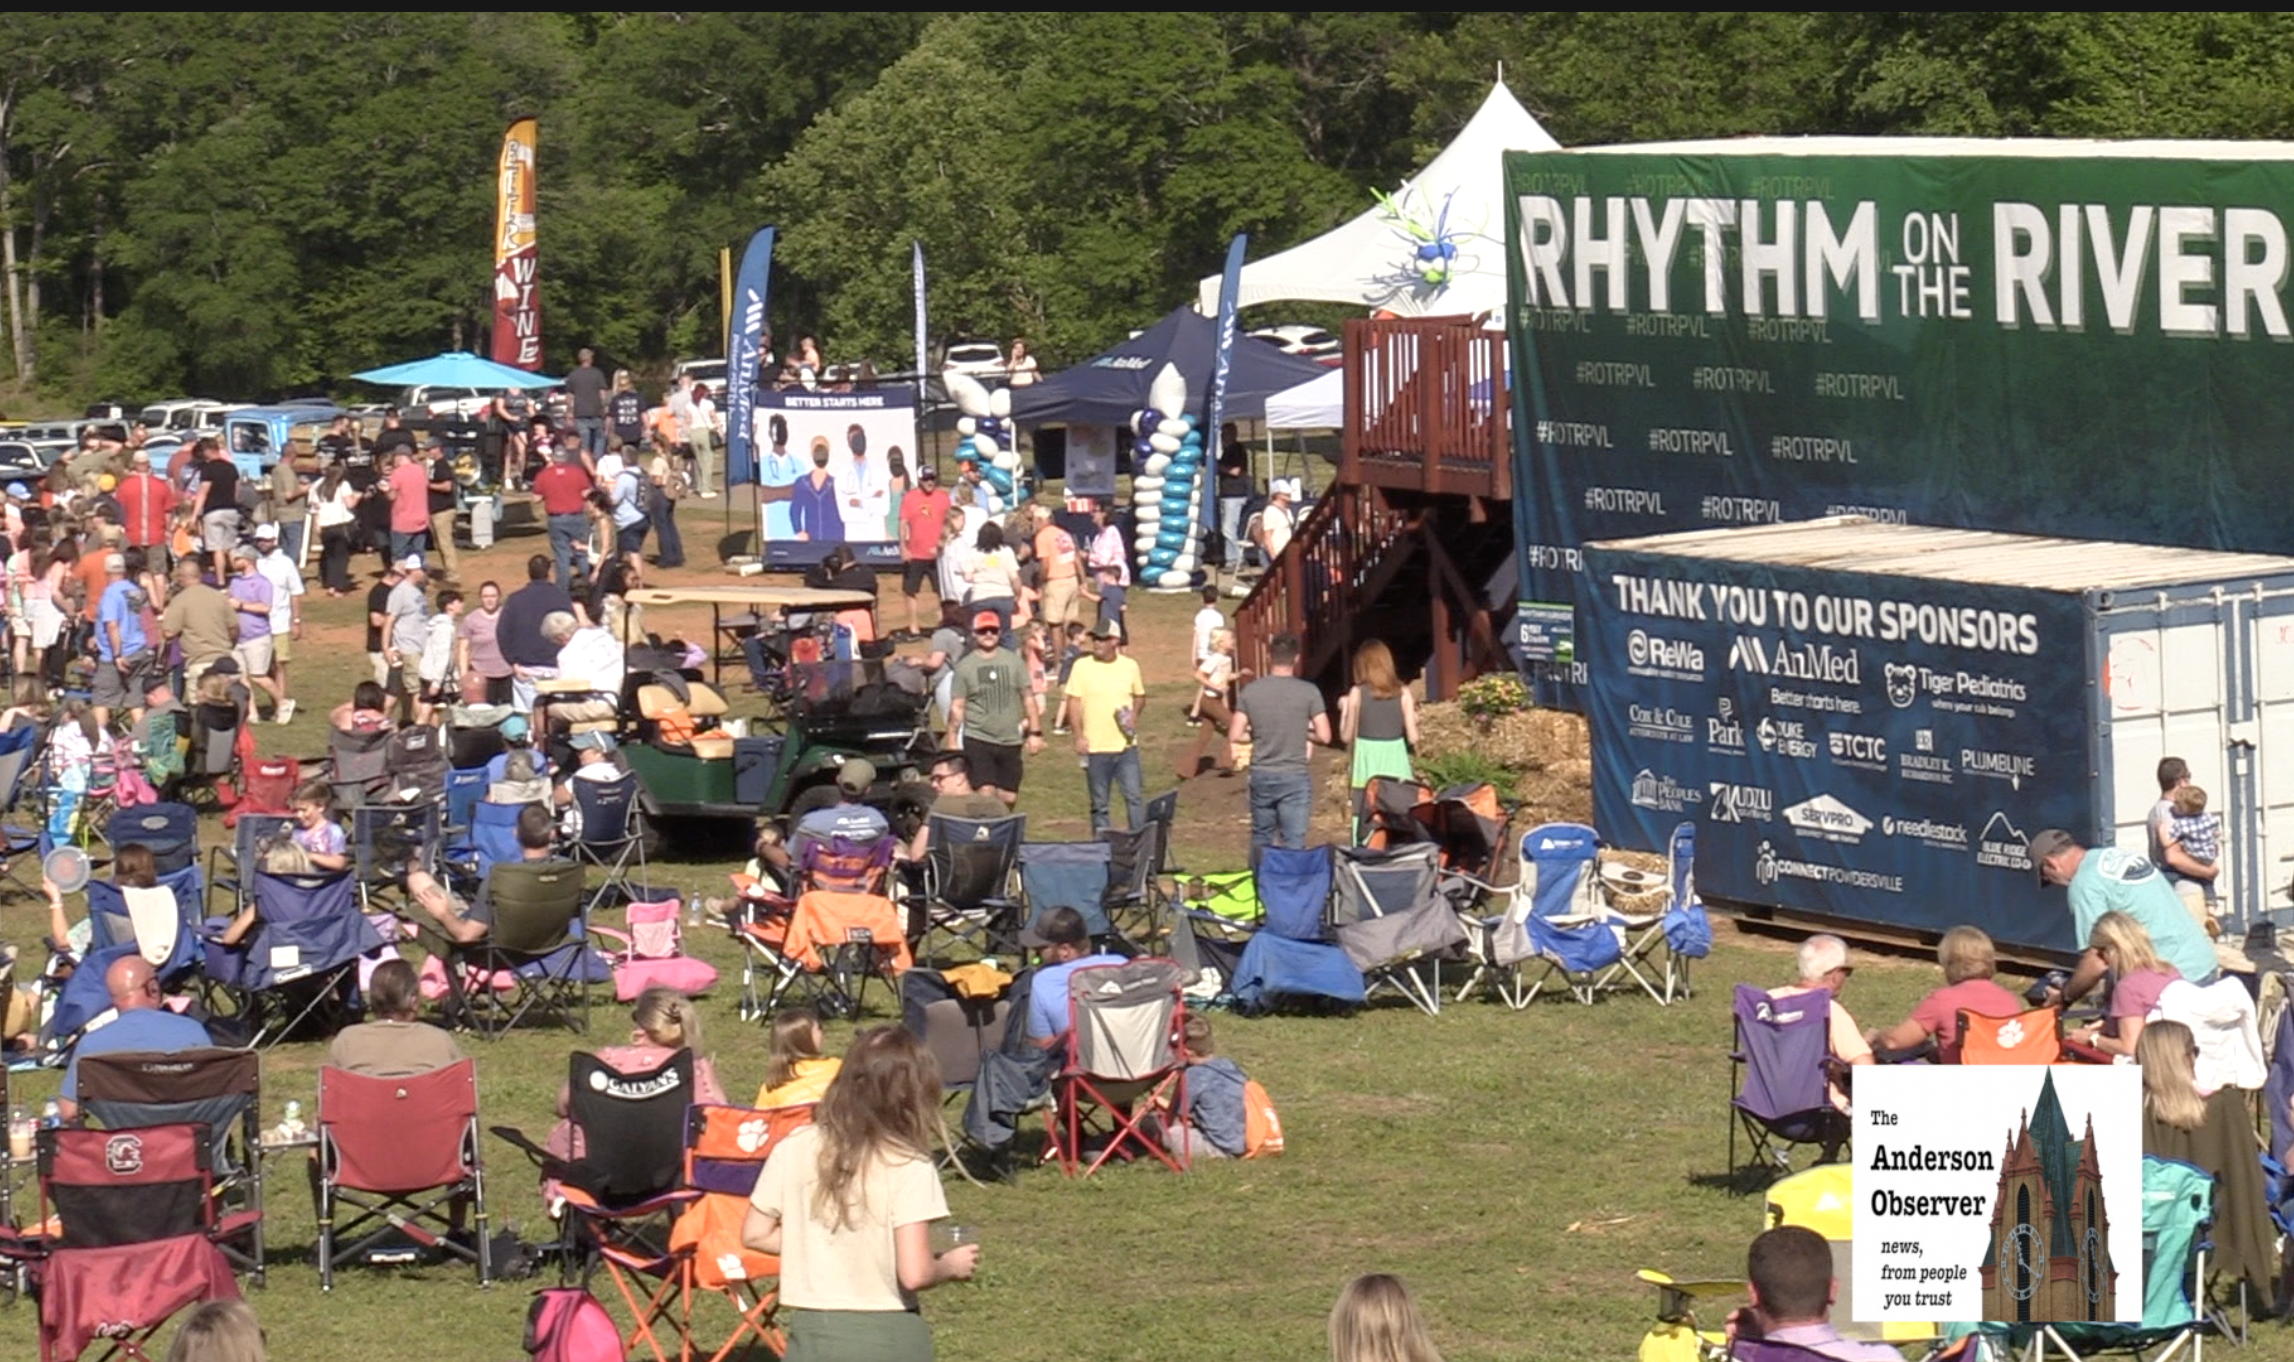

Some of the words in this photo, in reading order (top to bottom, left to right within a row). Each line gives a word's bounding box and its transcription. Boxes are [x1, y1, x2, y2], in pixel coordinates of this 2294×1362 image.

[1750, 175, 1835, 200] #ROTRPVL
[1903, 211, 1960, 265] ON
[1518, 194, 1881, 325] RHYTHM
[1993, 201, 2294, 342] RIVER
[1892, 264, 1973, 319] THE
[513, 257, 540, 363] WINE
[1519, 306, 1591, 333] #OTRPVL
[1627, 313, 1710, 339] #ROTRPVL
[1749, 315, 1832, 344] #ROTRPVL
[738, 338, 757, 439] AnMed
[1576, 361, 1655, 388] #ROTRPVL
[1693, 366, 1776, 395] #ROTRPVL
[1815, 372, 1904, 401] #ROTRPVL
[784, 396, 822, 408] BETTER
[822, 396, 858, 408] STARTS
[858, 395, 885, 407] HERE
[1536, 420, 1613, 449] #ROTRPVL
[1649, 427, 1734, 457] #ROTRPVL
[1771, 435, 1858, 464] #ROTRPVL
[1584, 486, 1666, 516] #ROTRPVL
[1702, 495, 1784, 524] #ROTRPVL
[1612, 574, 1707, 621] THANK
[1709, 582, 1767, 627] YOU
[1771, 589, 1809, 632] TO
[1814, 593, 1875, 639] OUR
[1878, 600, 2039, 656] SPONSORS
[1649, 637, 1705, 671] ReWa
[1771, 639, 1861, 684] AnMed
[1918, 667, 1955, 694] Tiger
[1956, 671, 2027, 702] Pediatrics
[1771, 687, 1804, 707] Better
[1805, 692, 1835, 712] starts
[1654, 707, 1664, 724] &
[1776, 720, 1805, 740] DUKE
[1707, 717, 1746, 747] Park
[1777, 739, 1818, 759] ENERGY
[1843, 734, 1887, 762] TCTC
[1900, 753, 1941, 771] BRADLEY
[1961, 748, 2035, 776] PLUMBLINE
[1726, 784, 1772, 823] KUDZU
[1801, 807, 1854, 828] SERVPRO
[1896, 818, 1967, 843] needlestock
